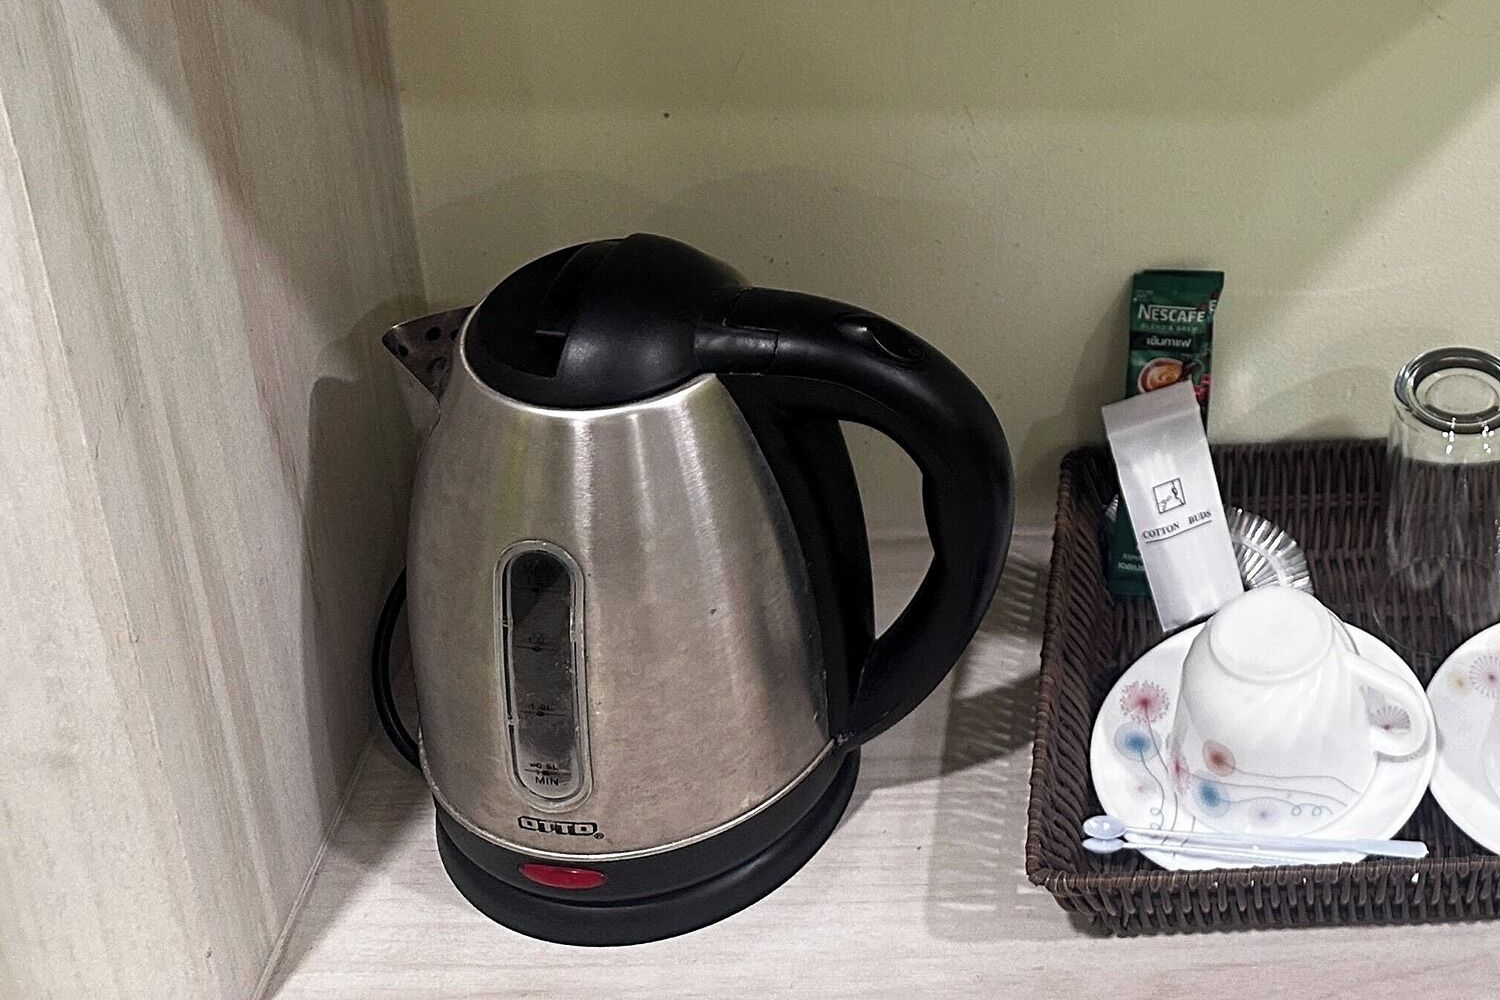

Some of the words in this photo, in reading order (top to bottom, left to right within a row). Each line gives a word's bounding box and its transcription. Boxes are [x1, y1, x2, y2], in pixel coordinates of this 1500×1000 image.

[1142, 522, 1180, 539] COTTON
[1188, 509, 1212, 525] BUDS
[535, 776, 559, 786] MIN
